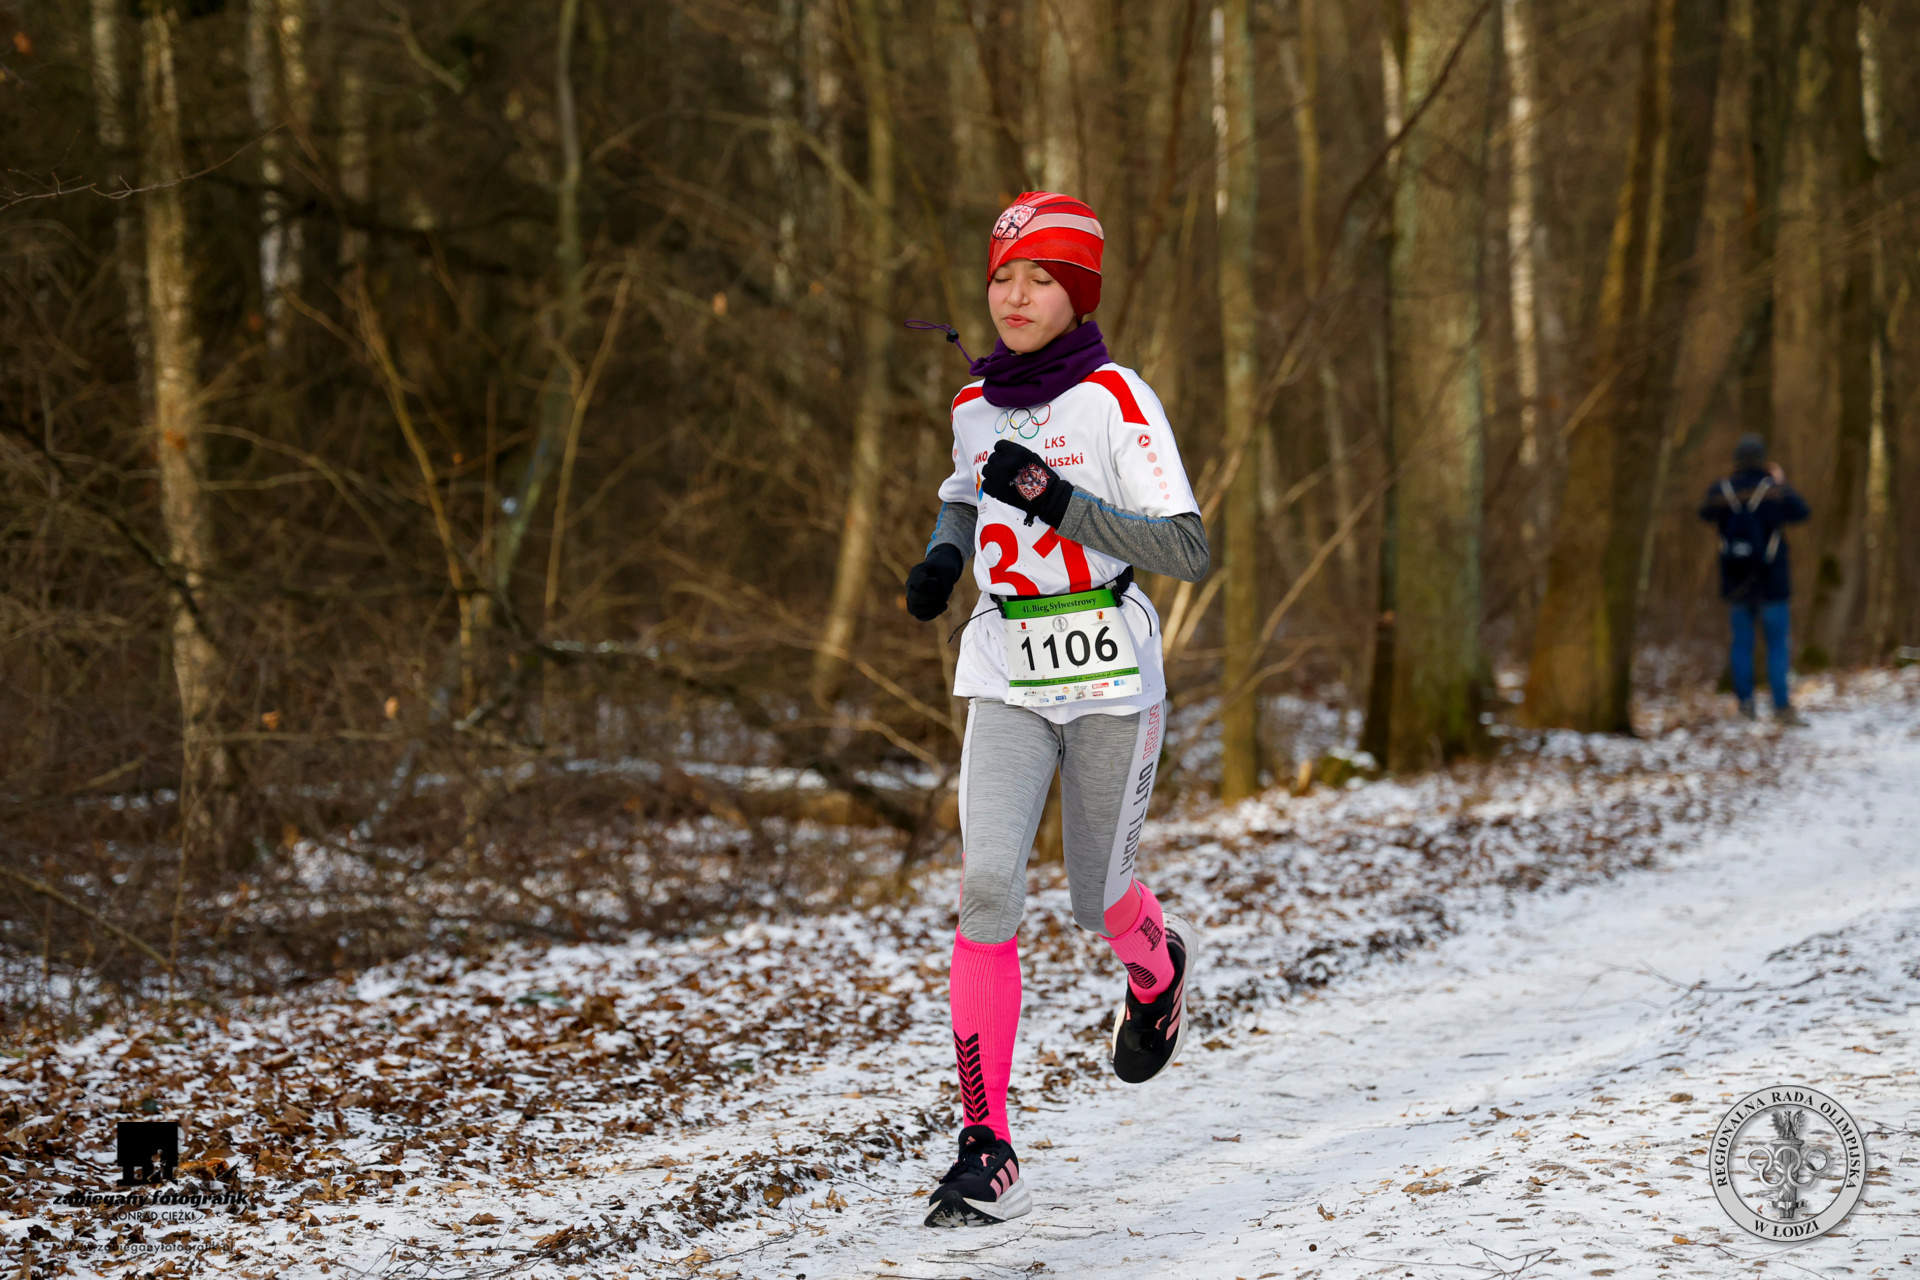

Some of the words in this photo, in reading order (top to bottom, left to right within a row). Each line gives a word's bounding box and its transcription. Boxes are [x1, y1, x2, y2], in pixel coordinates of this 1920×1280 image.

[1044, 435, 1066, 449] LKS
[1045, 452, 1084, 468] luszki
[1032, 604, 1049, 613] Bieg
[1049, 598, 1097, 612] Sylwestrowy
[1021, 625, 1118, 671] 1106
